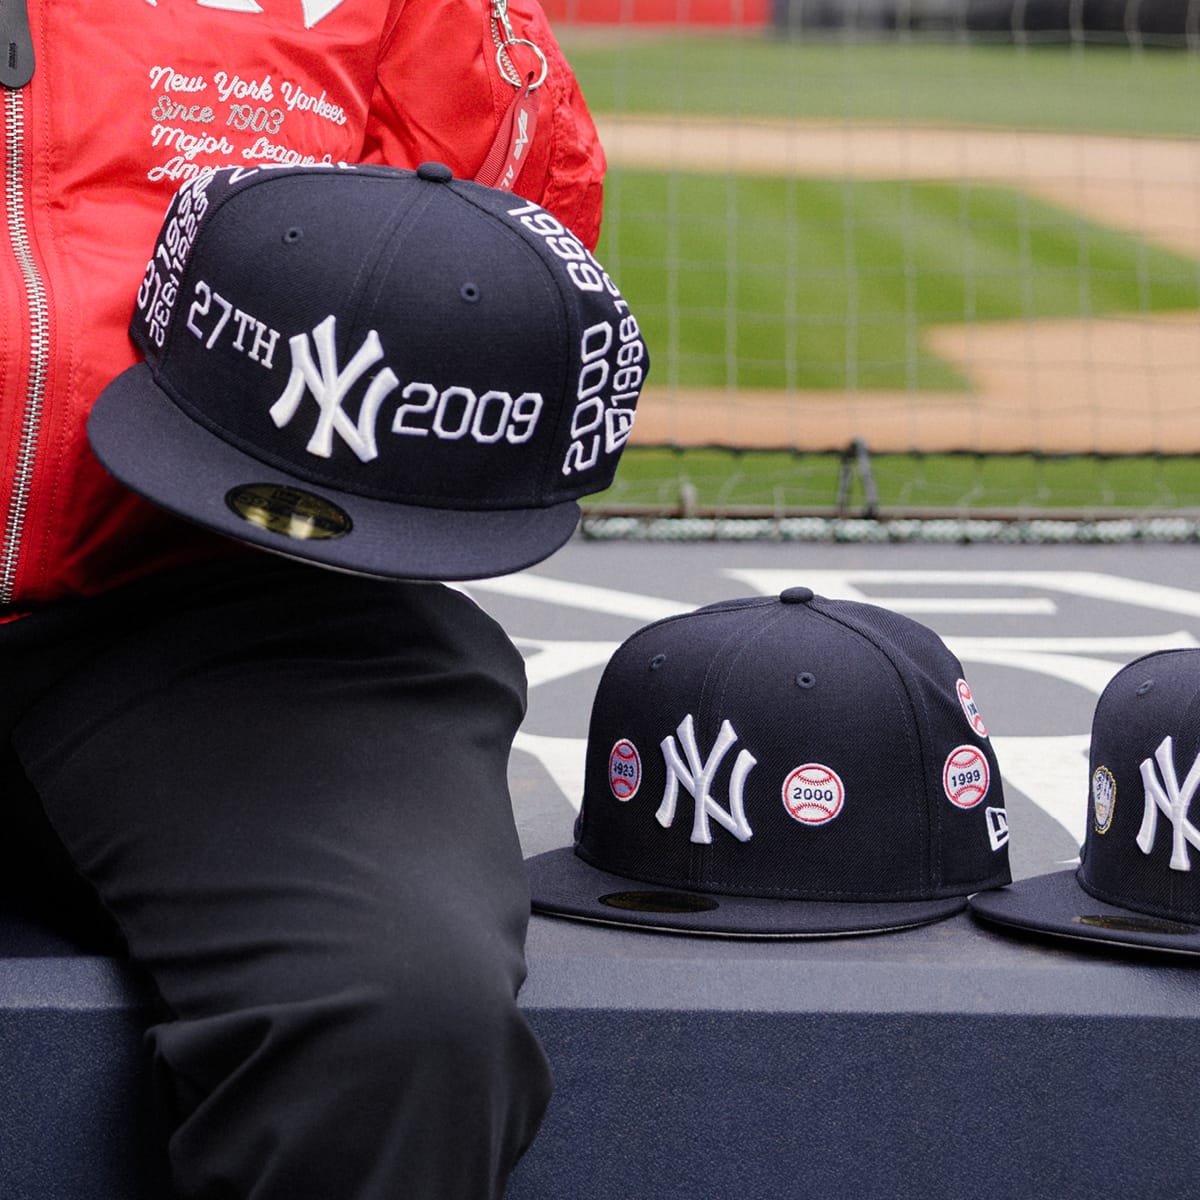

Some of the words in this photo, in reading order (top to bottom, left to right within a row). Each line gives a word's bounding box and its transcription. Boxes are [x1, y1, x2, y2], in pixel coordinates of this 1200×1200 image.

[149, 66, 208, 92] New
[214, 71, 274, 102] York
[280, 81, 347, 125] Yankees
[151, 95, 216, 124] Since
[226, 104, 285, 134] 1903
[151, 123, 234, 161] Major
[507, 200, 603, 292] 1999
[186, 280, 281, 369] 27TH
[269, 315, 400, 463] NY
[391, 382, 543, 444] 2009
[562, 320, 613, 476] 2000
[655, 713, 758, 844] NY
[793, 787, 834, 802] 2000
[951, 769, 981, 787] 1999
